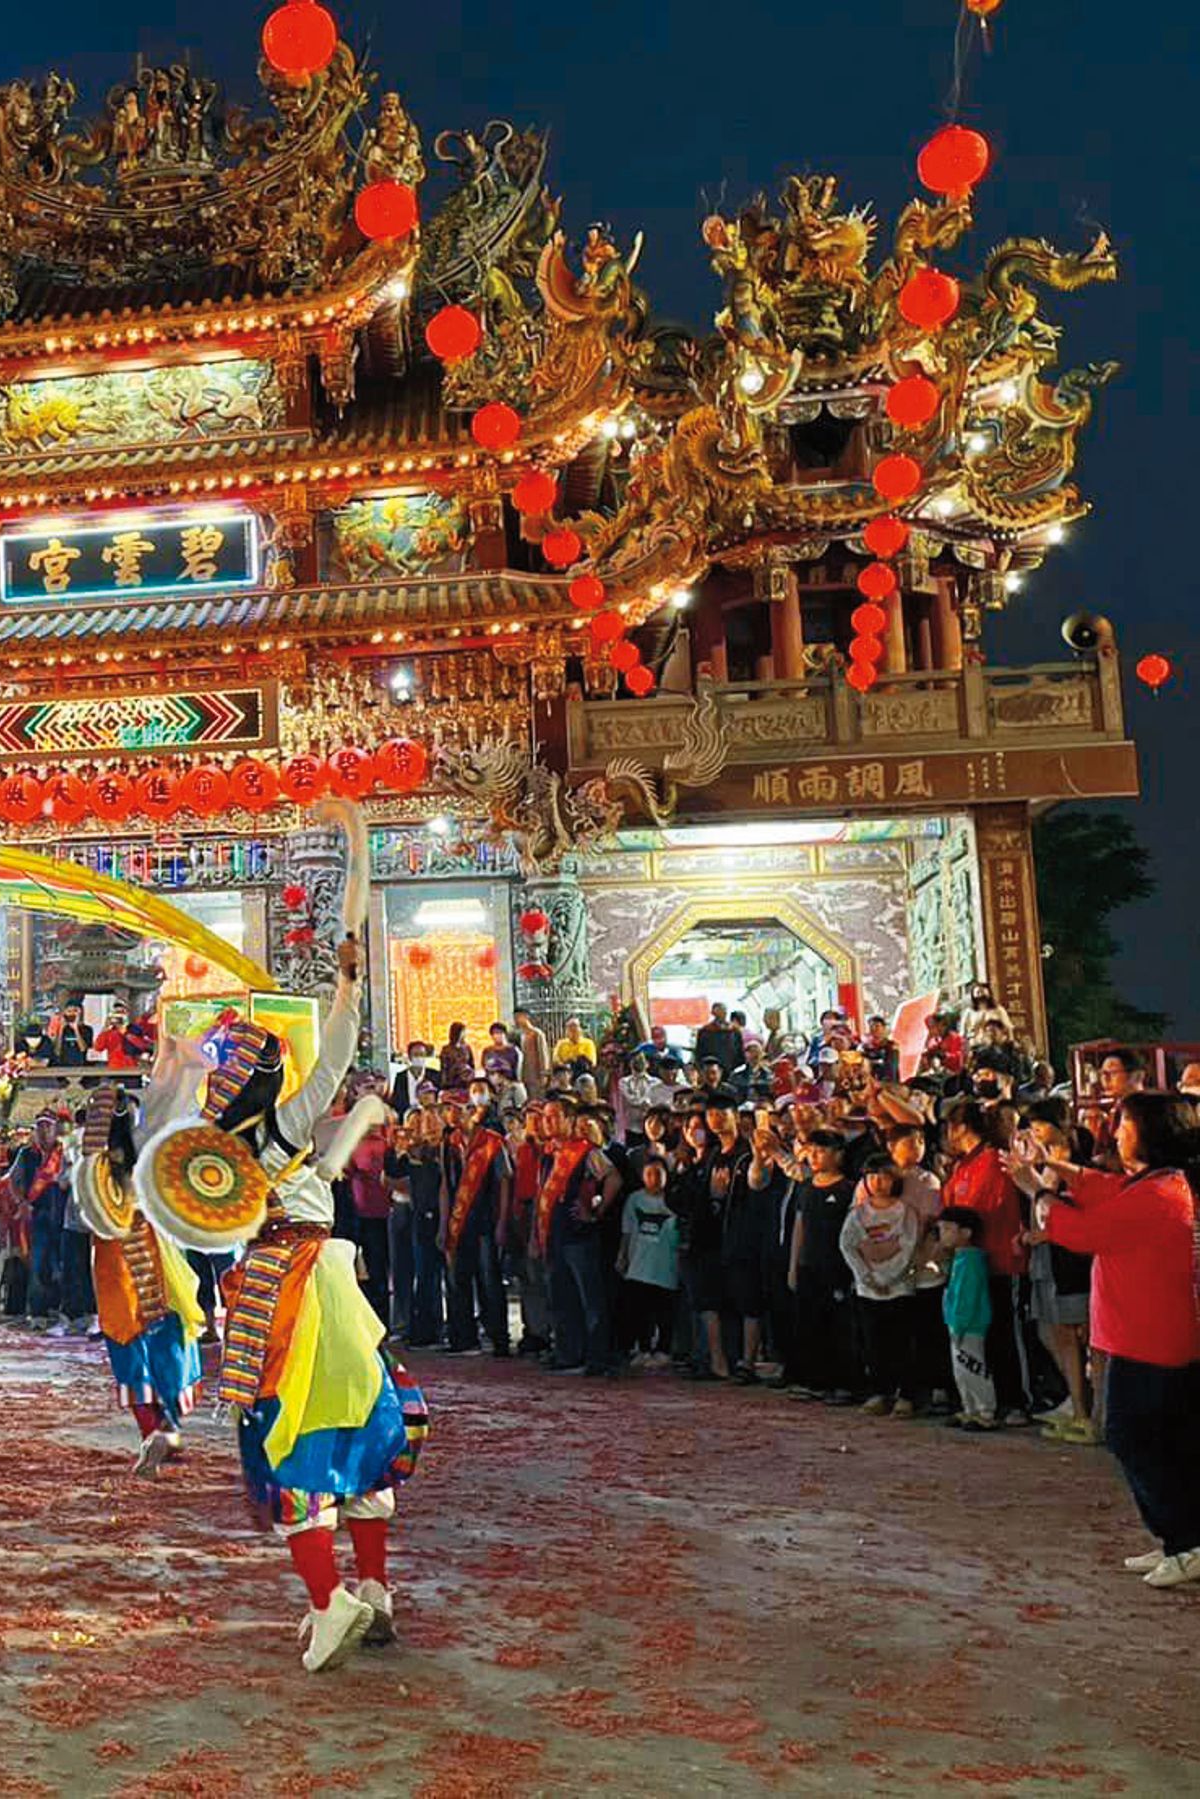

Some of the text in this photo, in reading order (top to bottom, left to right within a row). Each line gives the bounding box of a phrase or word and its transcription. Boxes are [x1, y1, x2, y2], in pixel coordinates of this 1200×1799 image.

[28, 524, 224, 593] 碧雲宮
[753, 760, 933, 804] 風調雨順
